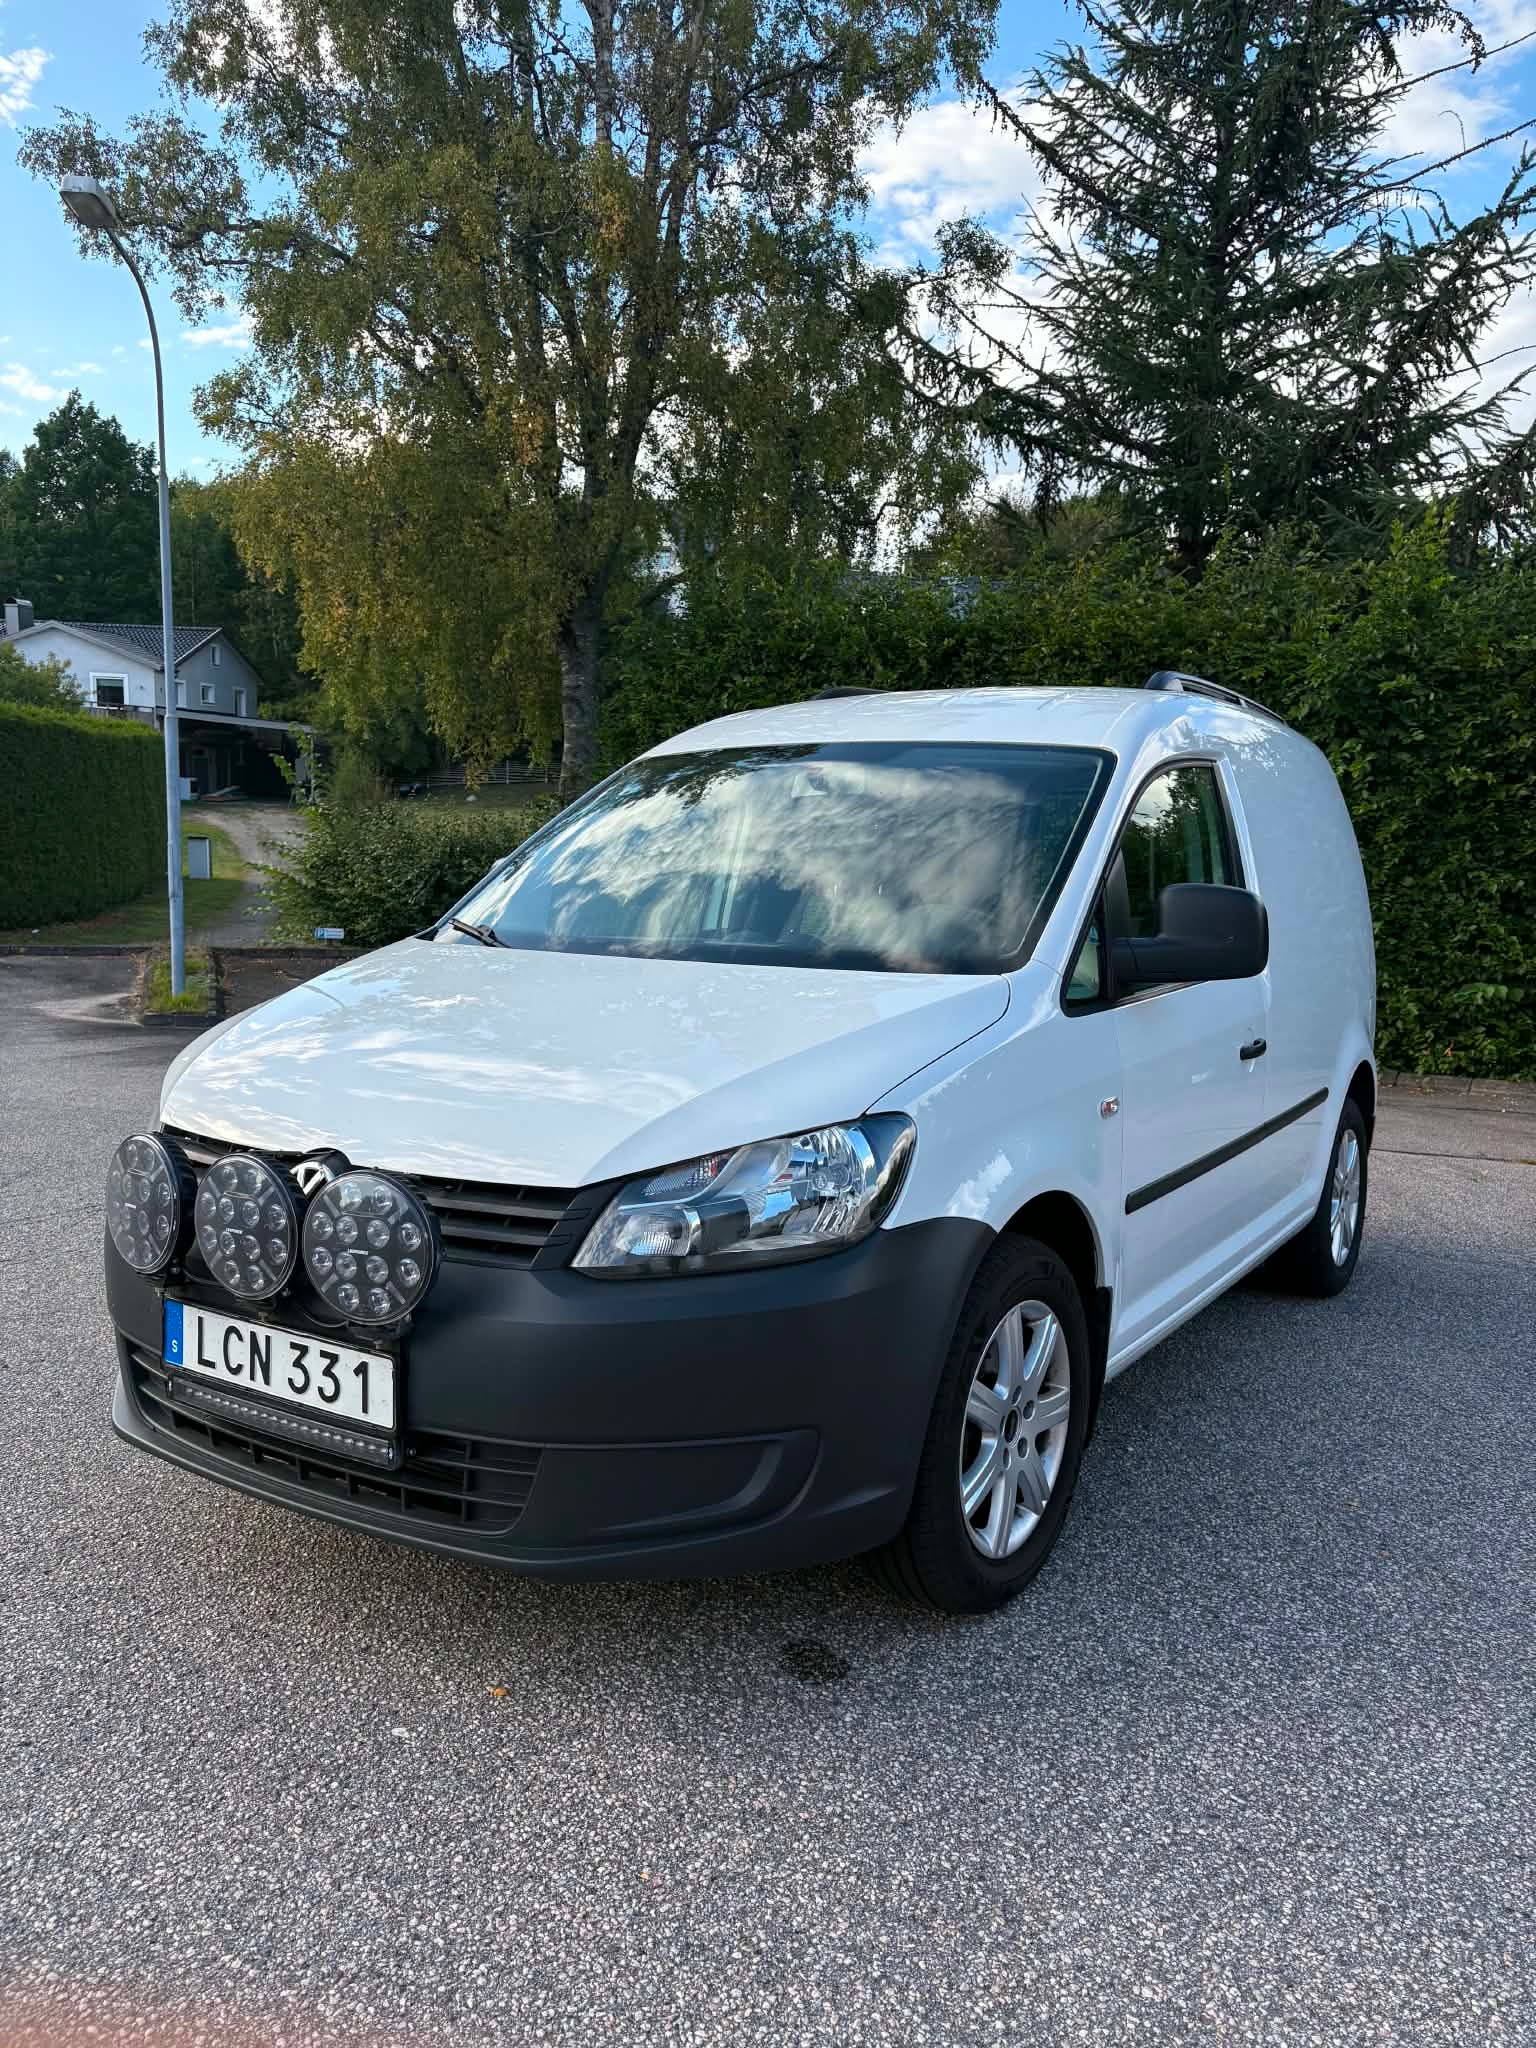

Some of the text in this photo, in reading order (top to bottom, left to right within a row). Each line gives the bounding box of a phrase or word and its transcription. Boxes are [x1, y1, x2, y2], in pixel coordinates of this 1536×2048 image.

[171, 1339, 178, 1353] S
[197, 1315, 369, 1414] LCN 331
